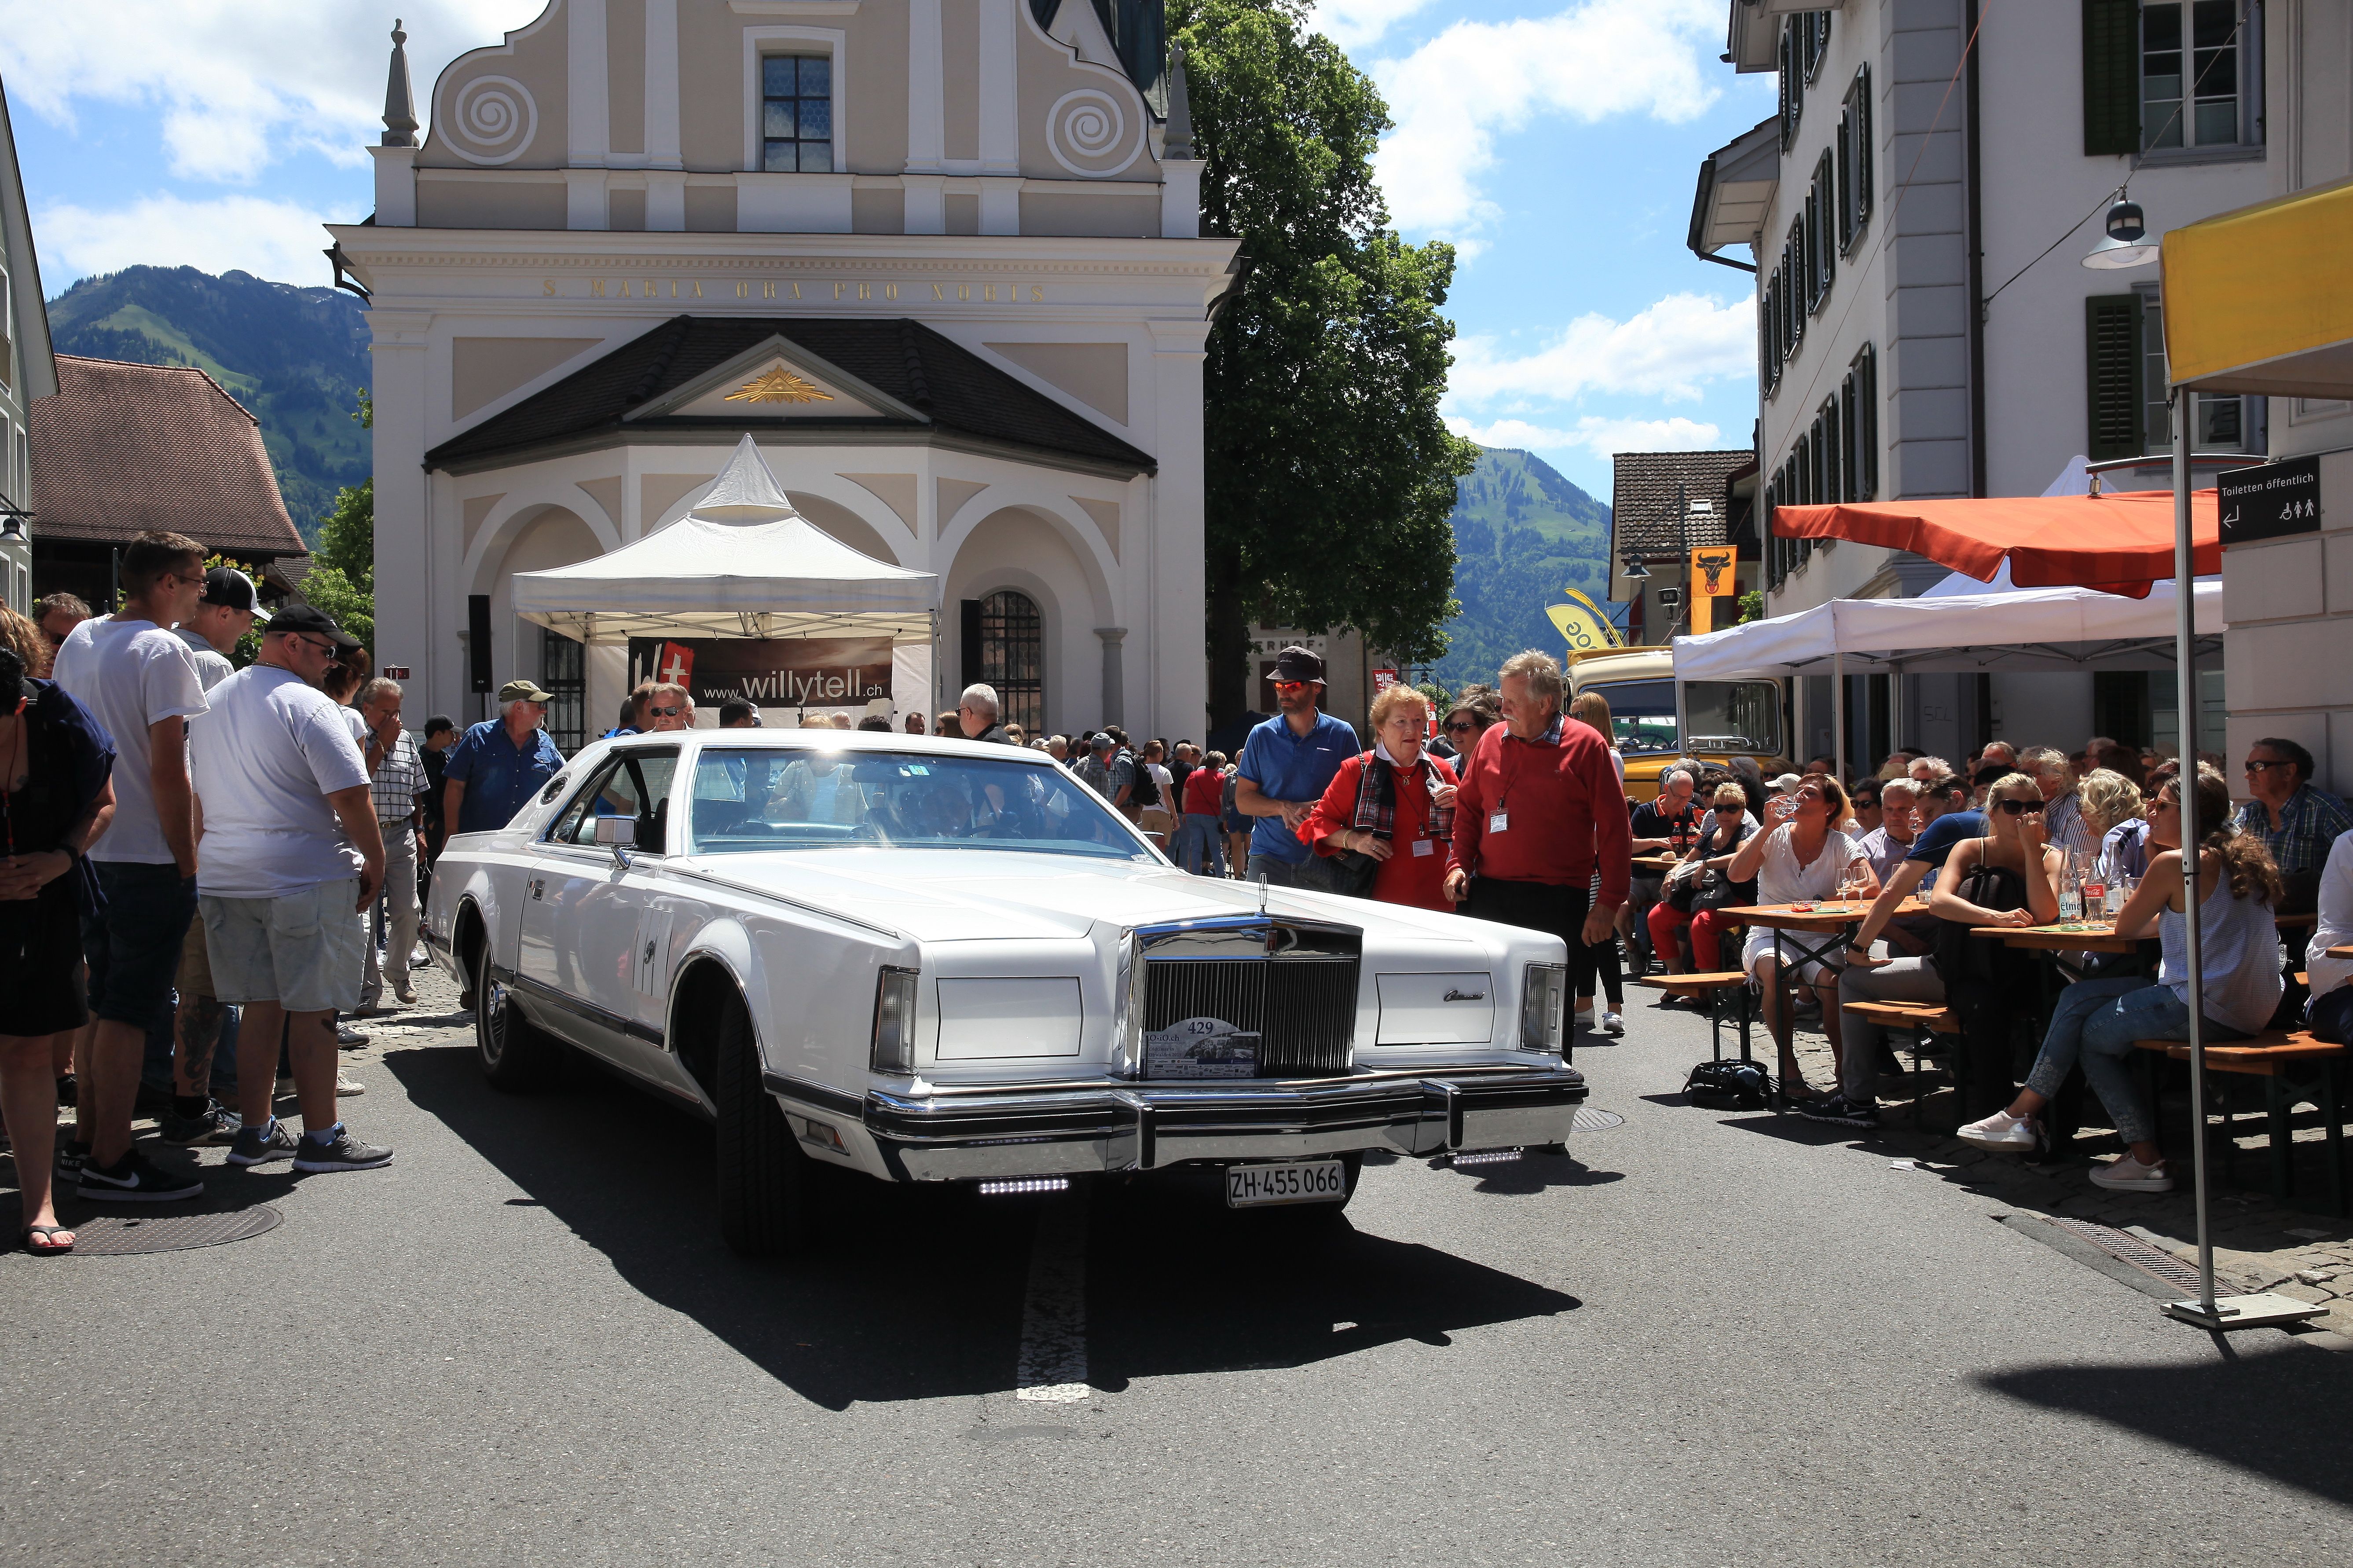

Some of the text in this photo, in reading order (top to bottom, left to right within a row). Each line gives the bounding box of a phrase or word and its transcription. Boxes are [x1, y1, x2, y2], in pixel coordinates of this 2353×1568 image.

[590, 280, 704, 297] MARIA
[737, 282, 803, 300] ORA
[833, 283, 898, 300] PRO
[931, 284, 1044, 302] NOBIS
[2222, 473, 2313, 496] Toiletten öffentlich
[704, 669, 883, 706] www.willytell.ch
[2060, 902, 2082, 911] Elme
[1188, 1021, 1213, 1034] 429
[61, 1158, 81, 1167] NIKE
